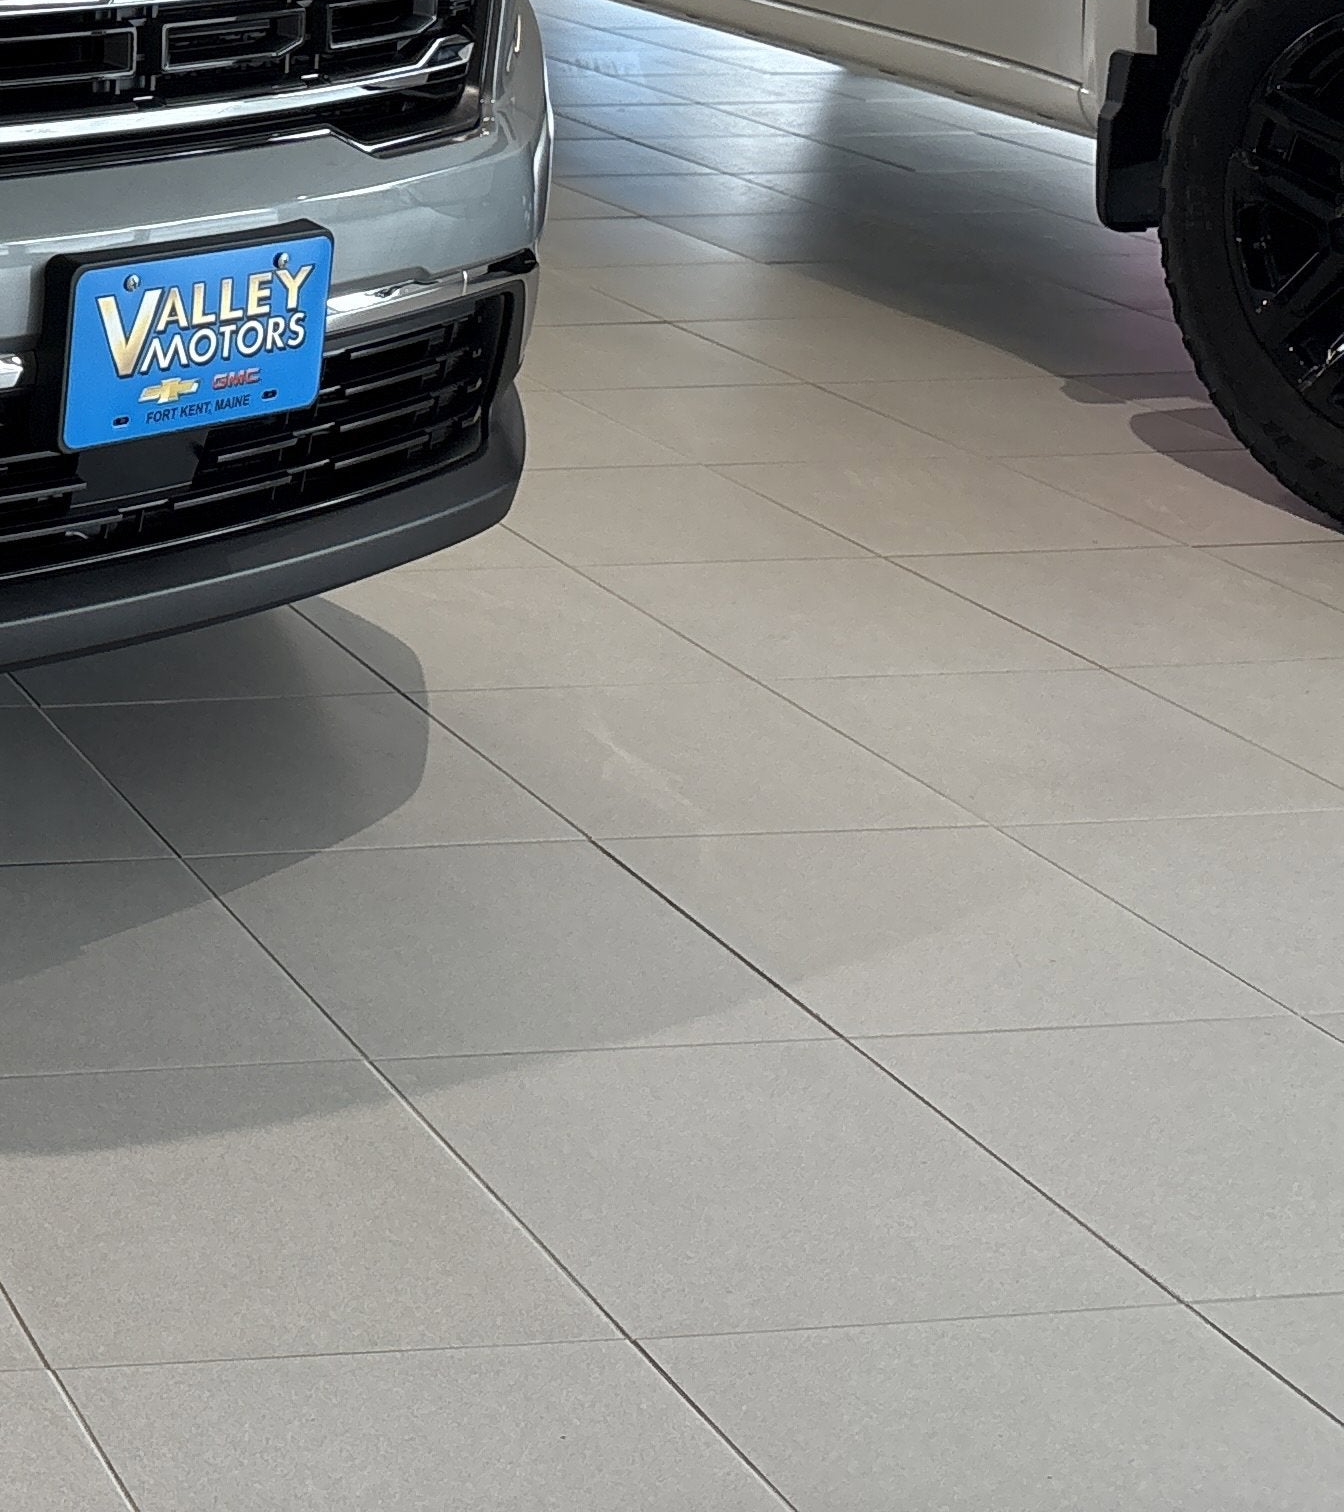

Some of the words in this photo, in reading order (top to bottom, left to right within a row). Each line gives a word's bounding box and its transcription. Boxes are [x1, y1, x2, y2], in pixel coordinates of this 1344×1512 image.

[95, 263, 316, 380] VALLEY
[137, 310, 307, 376] MOTORS
[212, 367, 261, 390] GMC
[146, 407, 179, 425] FORT
[180, 401, 212, 417] KENT,
[214, 393, 251, 411] MAINE
